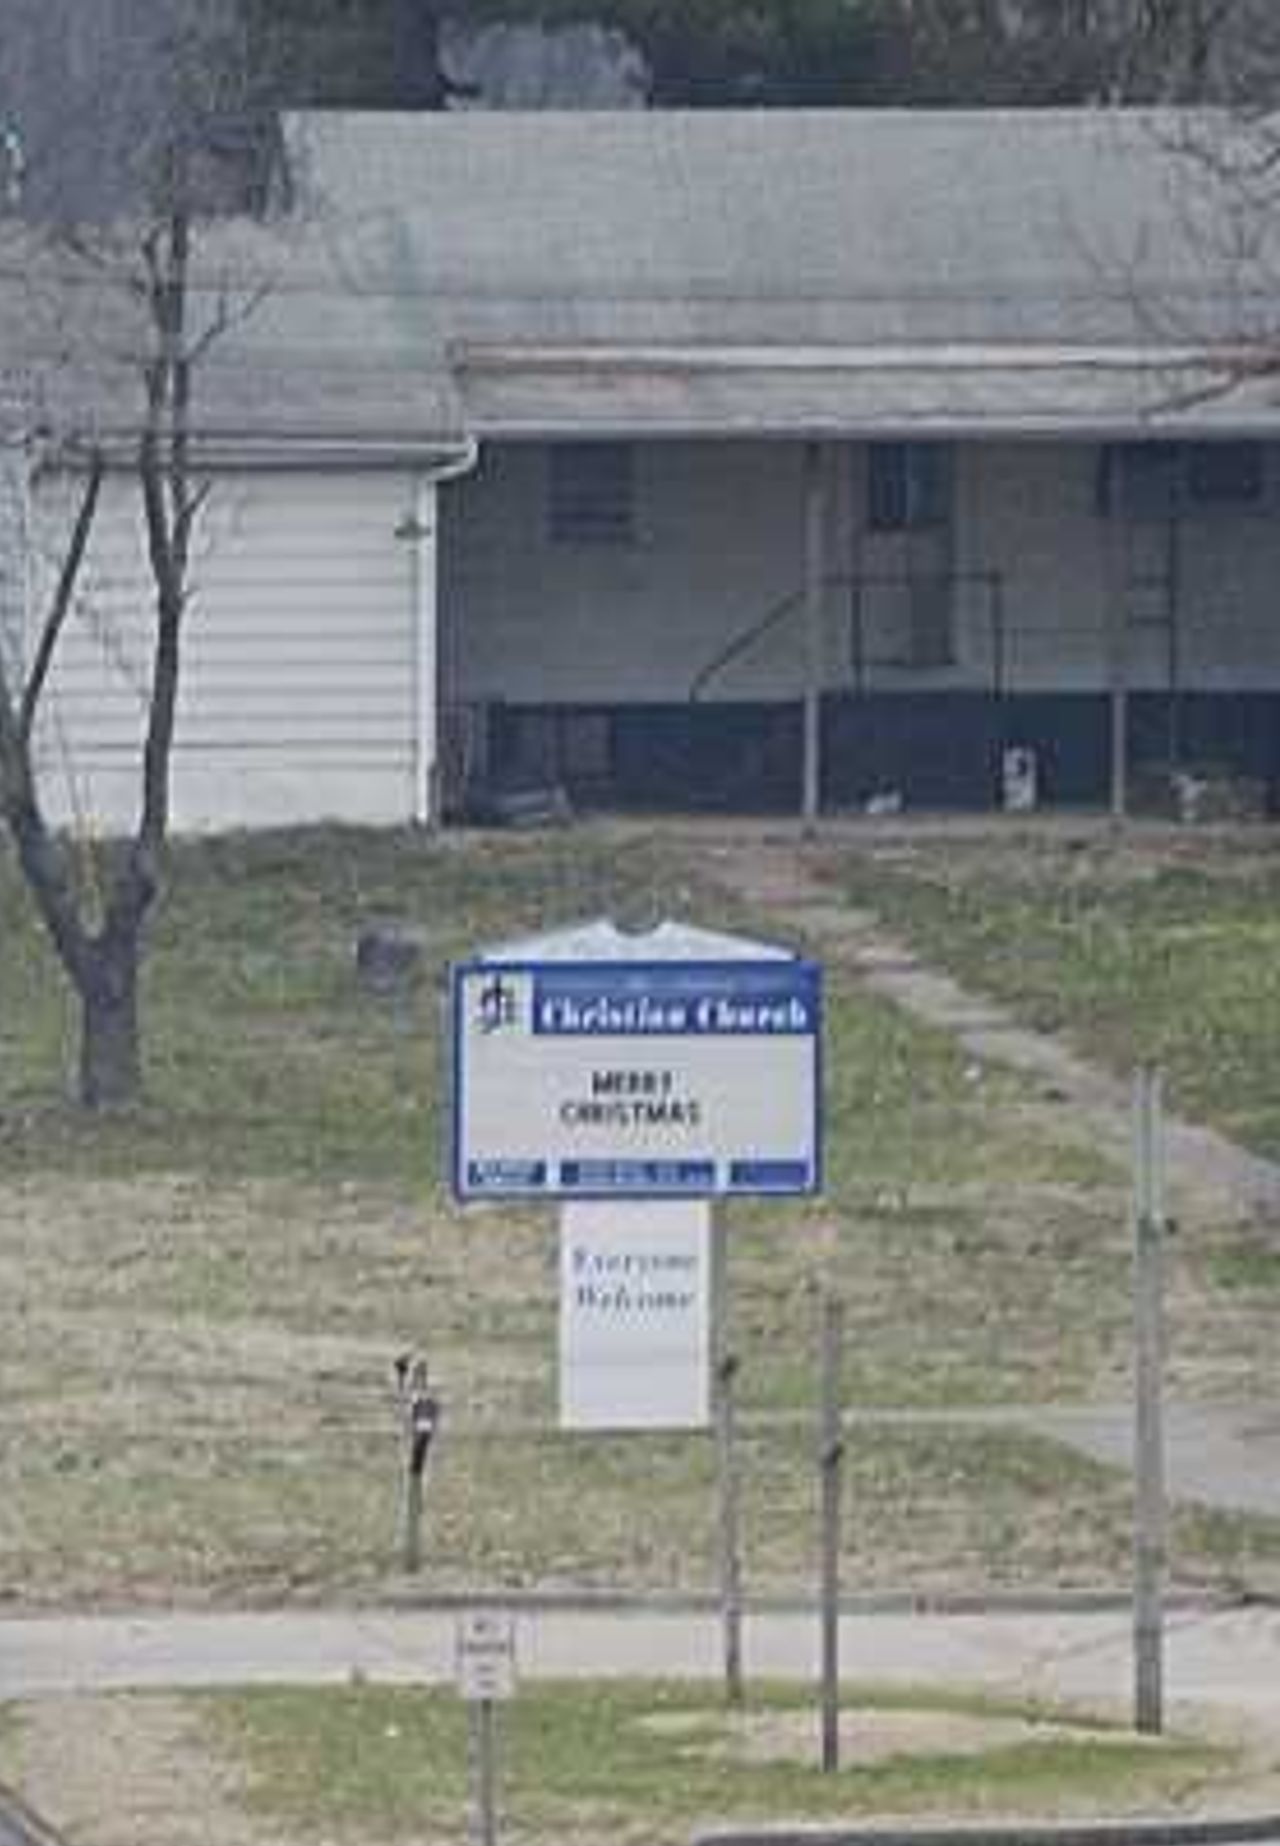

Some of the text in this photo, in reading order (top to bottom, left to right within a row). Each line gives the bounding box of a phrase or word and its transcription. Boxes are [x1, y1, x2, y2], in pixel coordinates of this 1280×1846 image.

[541, 998, 807, 1028] Christian Church
[592, 1071, 672, 1095] MERRY
[577, 1285, 696, 1310] Welcome
